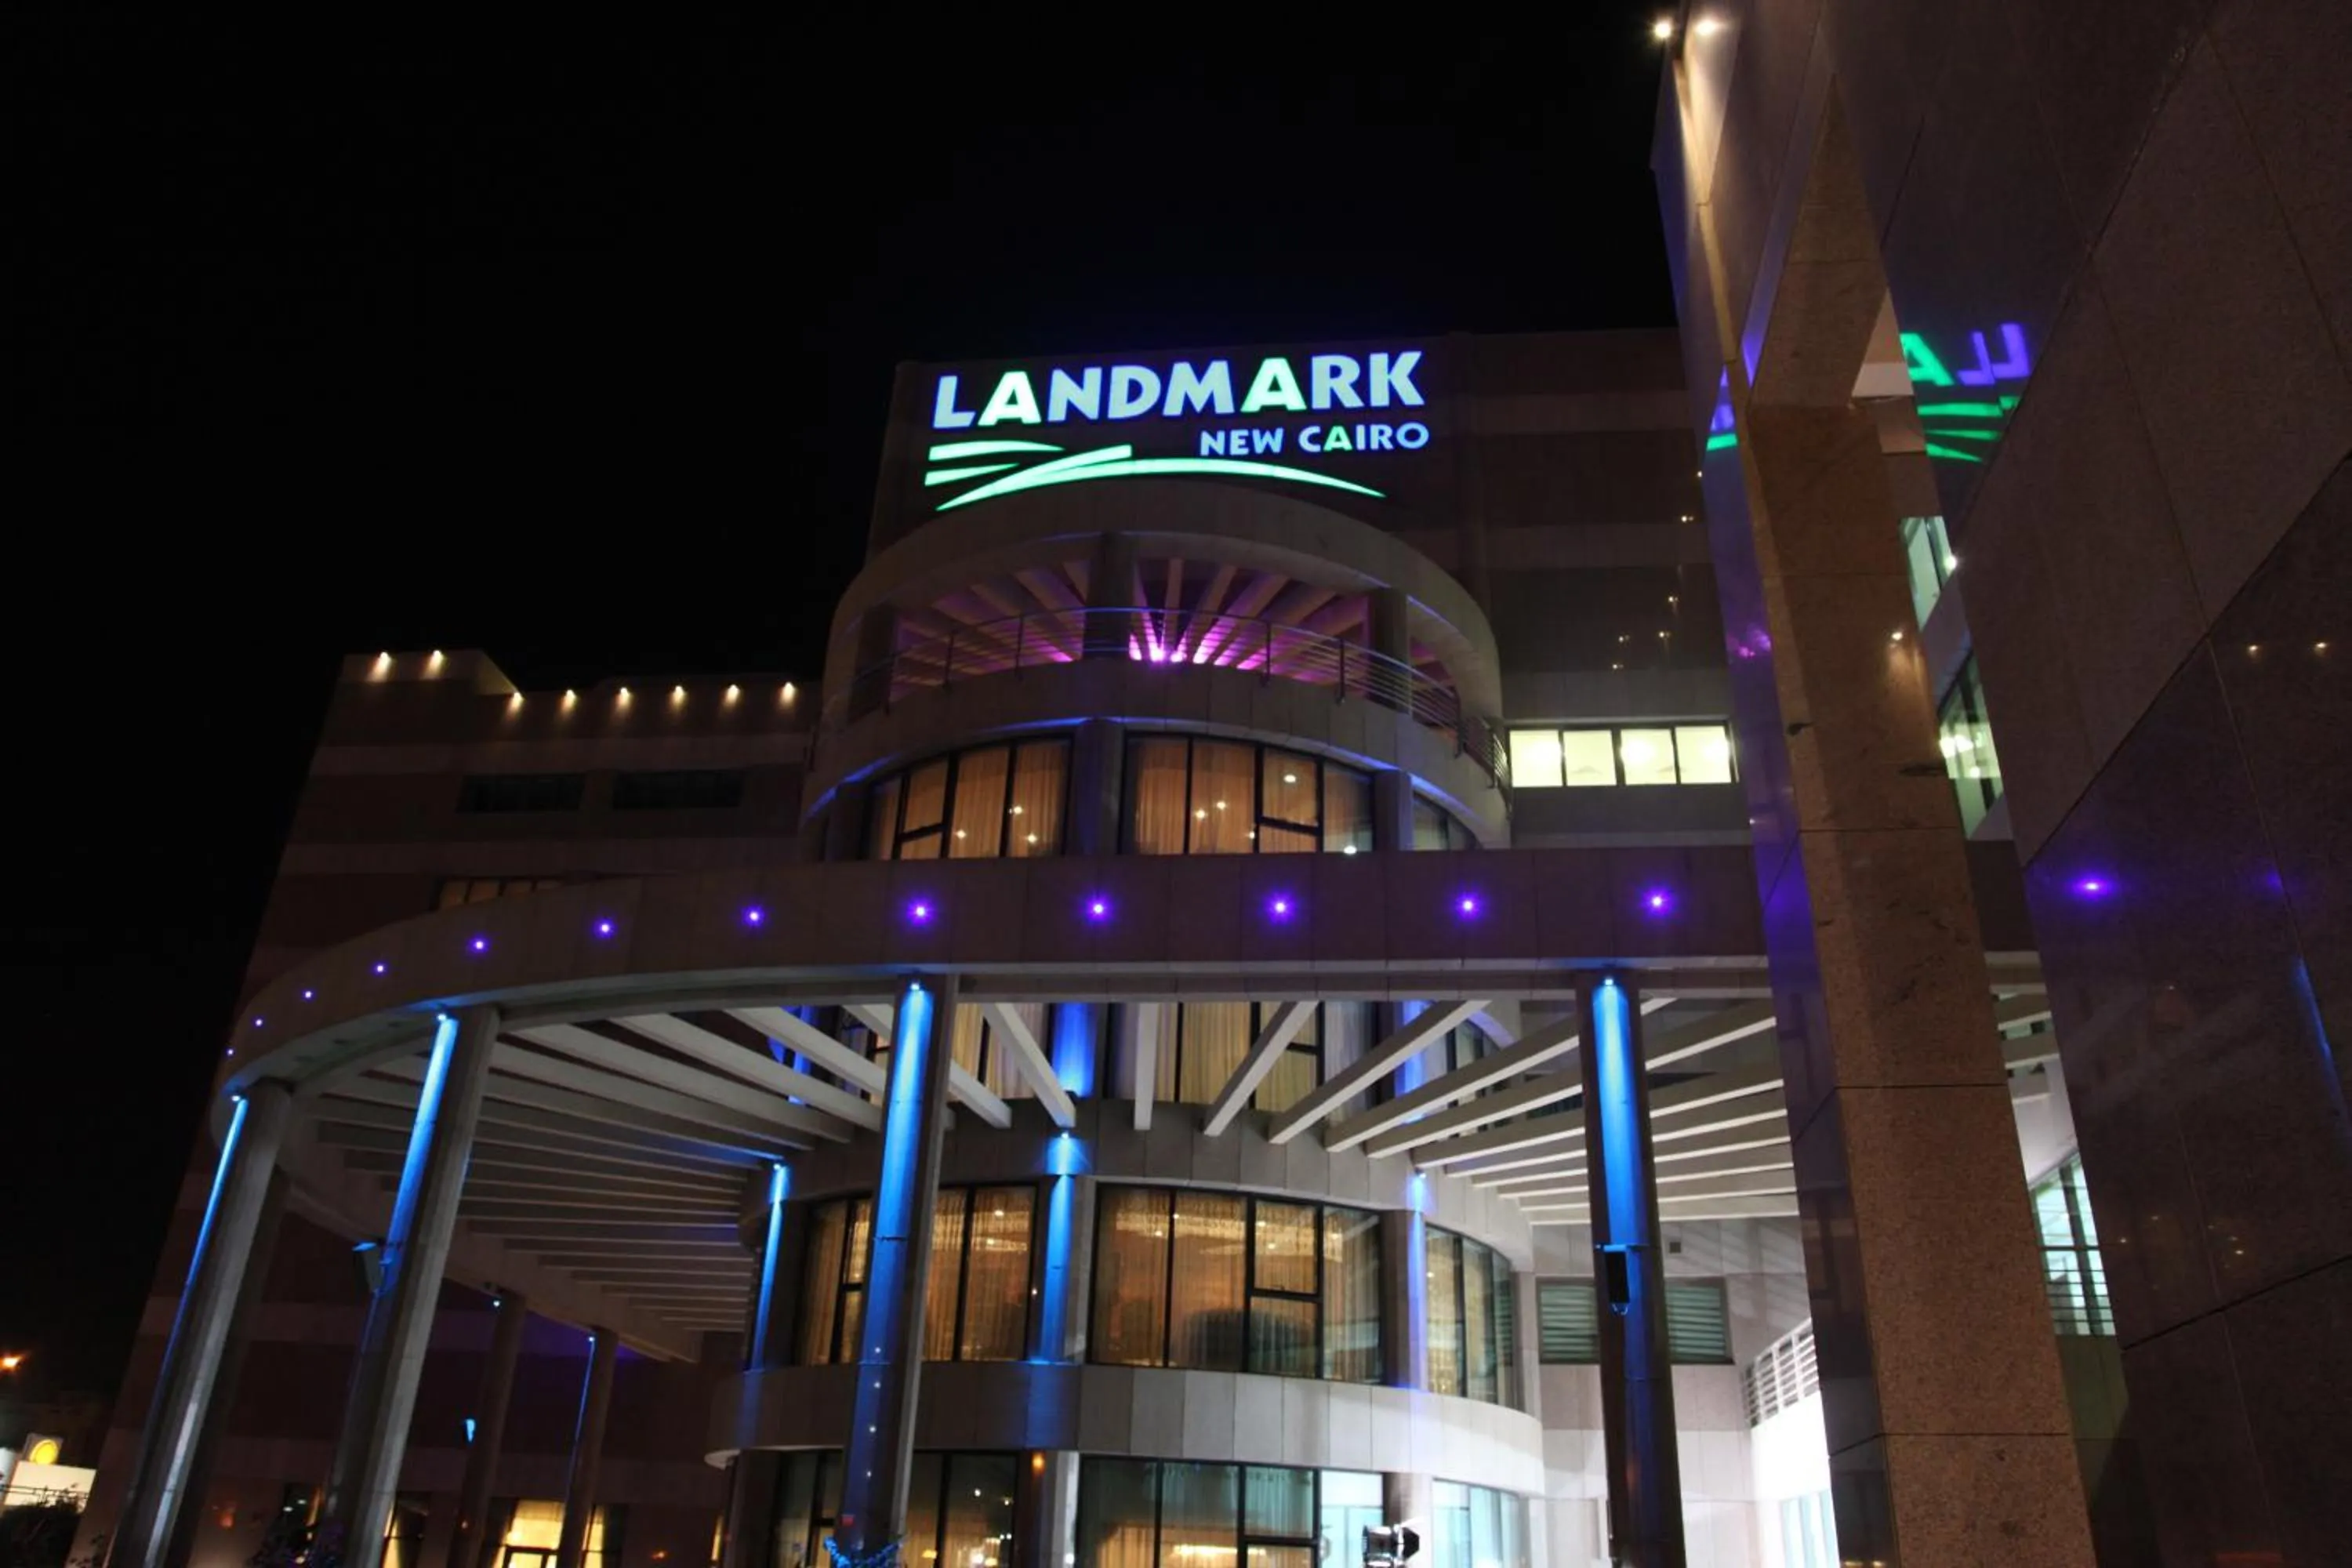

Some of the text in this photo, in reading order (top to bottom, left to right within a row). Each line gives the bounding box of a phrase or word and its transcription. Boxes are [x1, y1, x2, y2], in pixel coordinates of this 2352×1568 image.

[932, 350, 1425, 429] LANDMARK
[1199, 420, 1429, 457] NEW CAIRO
